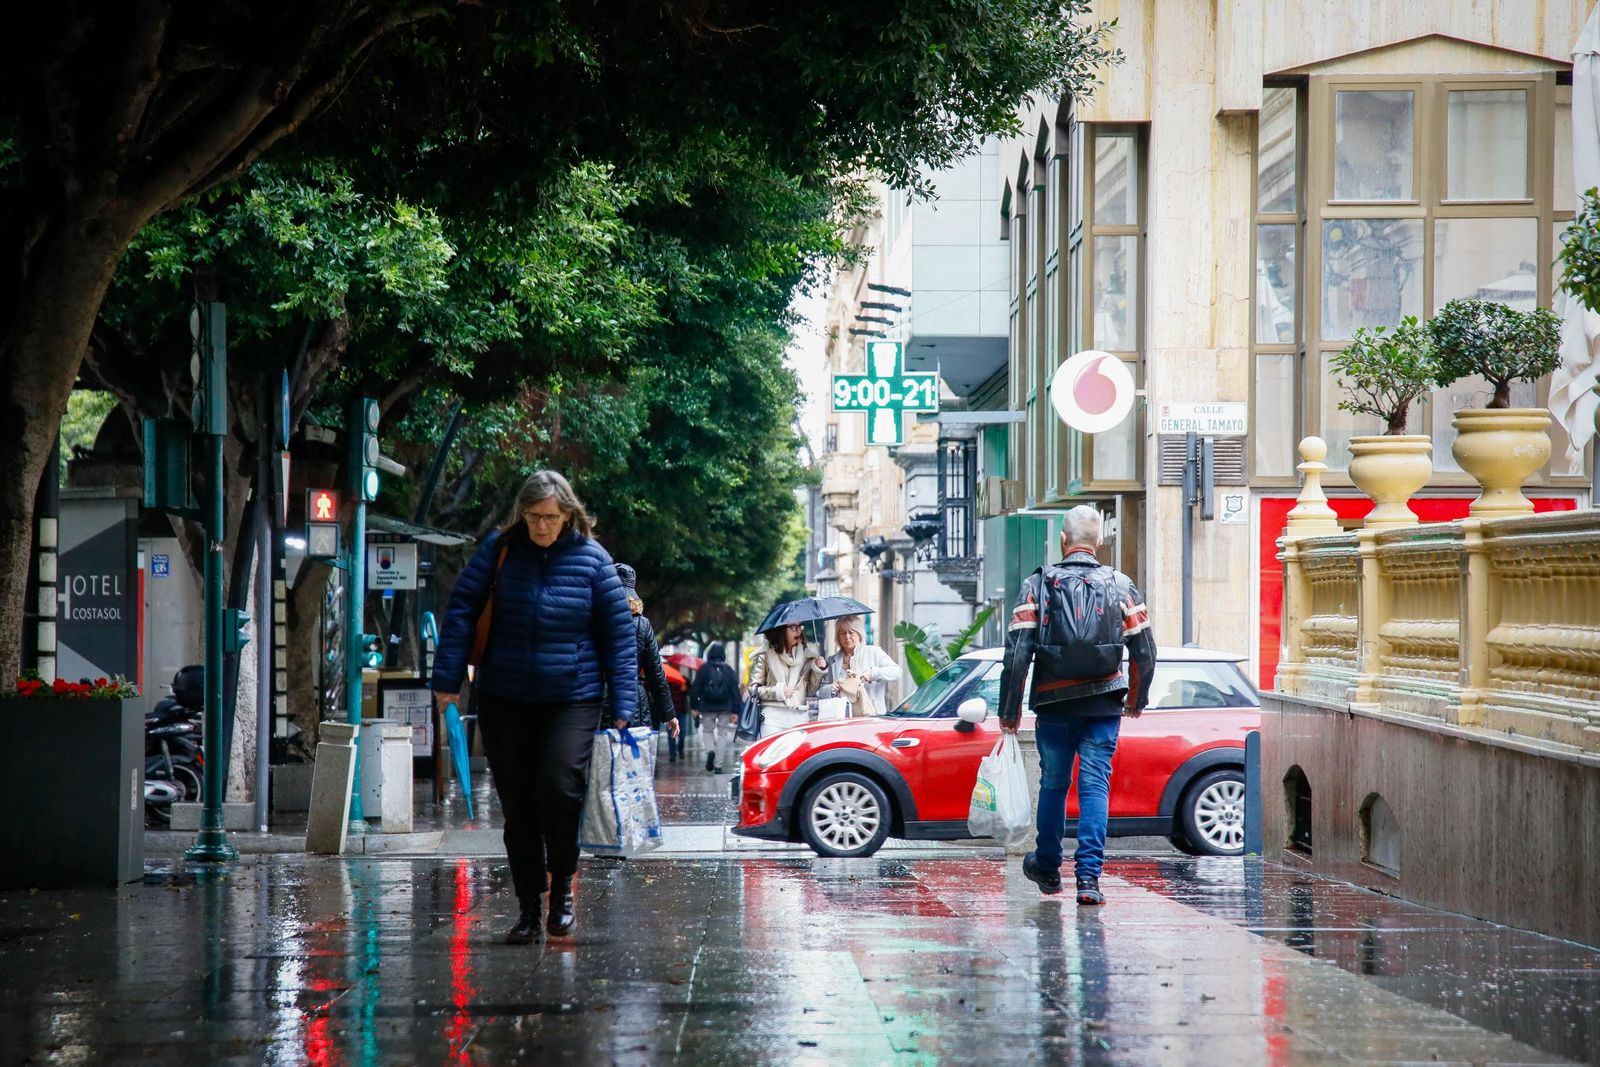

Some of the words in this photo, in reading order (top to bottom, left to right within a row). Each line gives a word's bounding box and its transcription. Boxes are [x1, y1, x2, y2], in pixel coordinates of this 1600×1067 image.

[1194, 406, 1224, 414] CALLE
[1161, 419, 1204, 431] GENERAL
[1208, 419, 1243, 431] TAMAYO
[73, 608, 121, 619] COSTASOL
